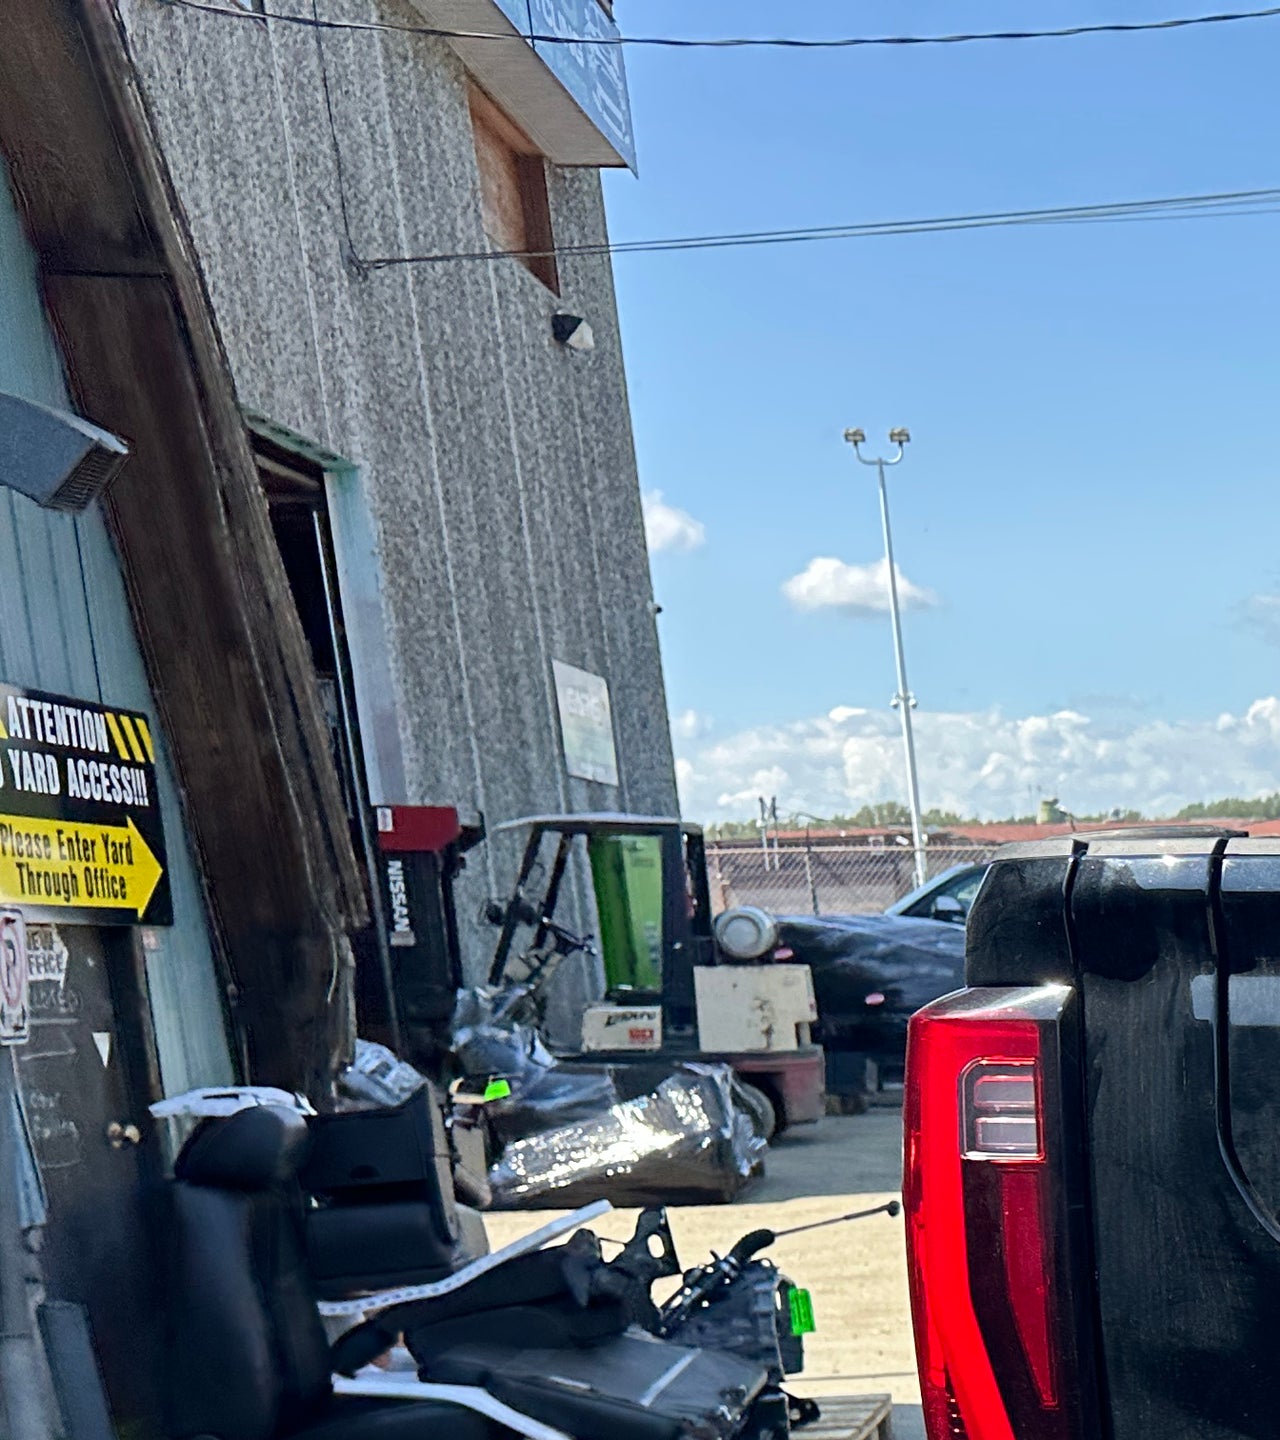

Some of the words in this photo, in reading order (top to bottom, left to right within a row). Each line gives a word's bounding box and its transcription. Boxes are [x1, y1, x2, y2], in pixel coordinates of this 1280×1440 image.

[7, 696, 110, 754] ATTENTION
[7, 749, 61, 796] YARD
[66, 758, 150, 807] ACCESS!!!
[0, 823, 51, 860] Please
[56, 829, 97, 863] Enter
[101, 833, 134, 866] Yard
[15, 862, 79, 903] Through
[83, 866, 127, 900] Office
[387, 860, 411, 932] NISSAN
